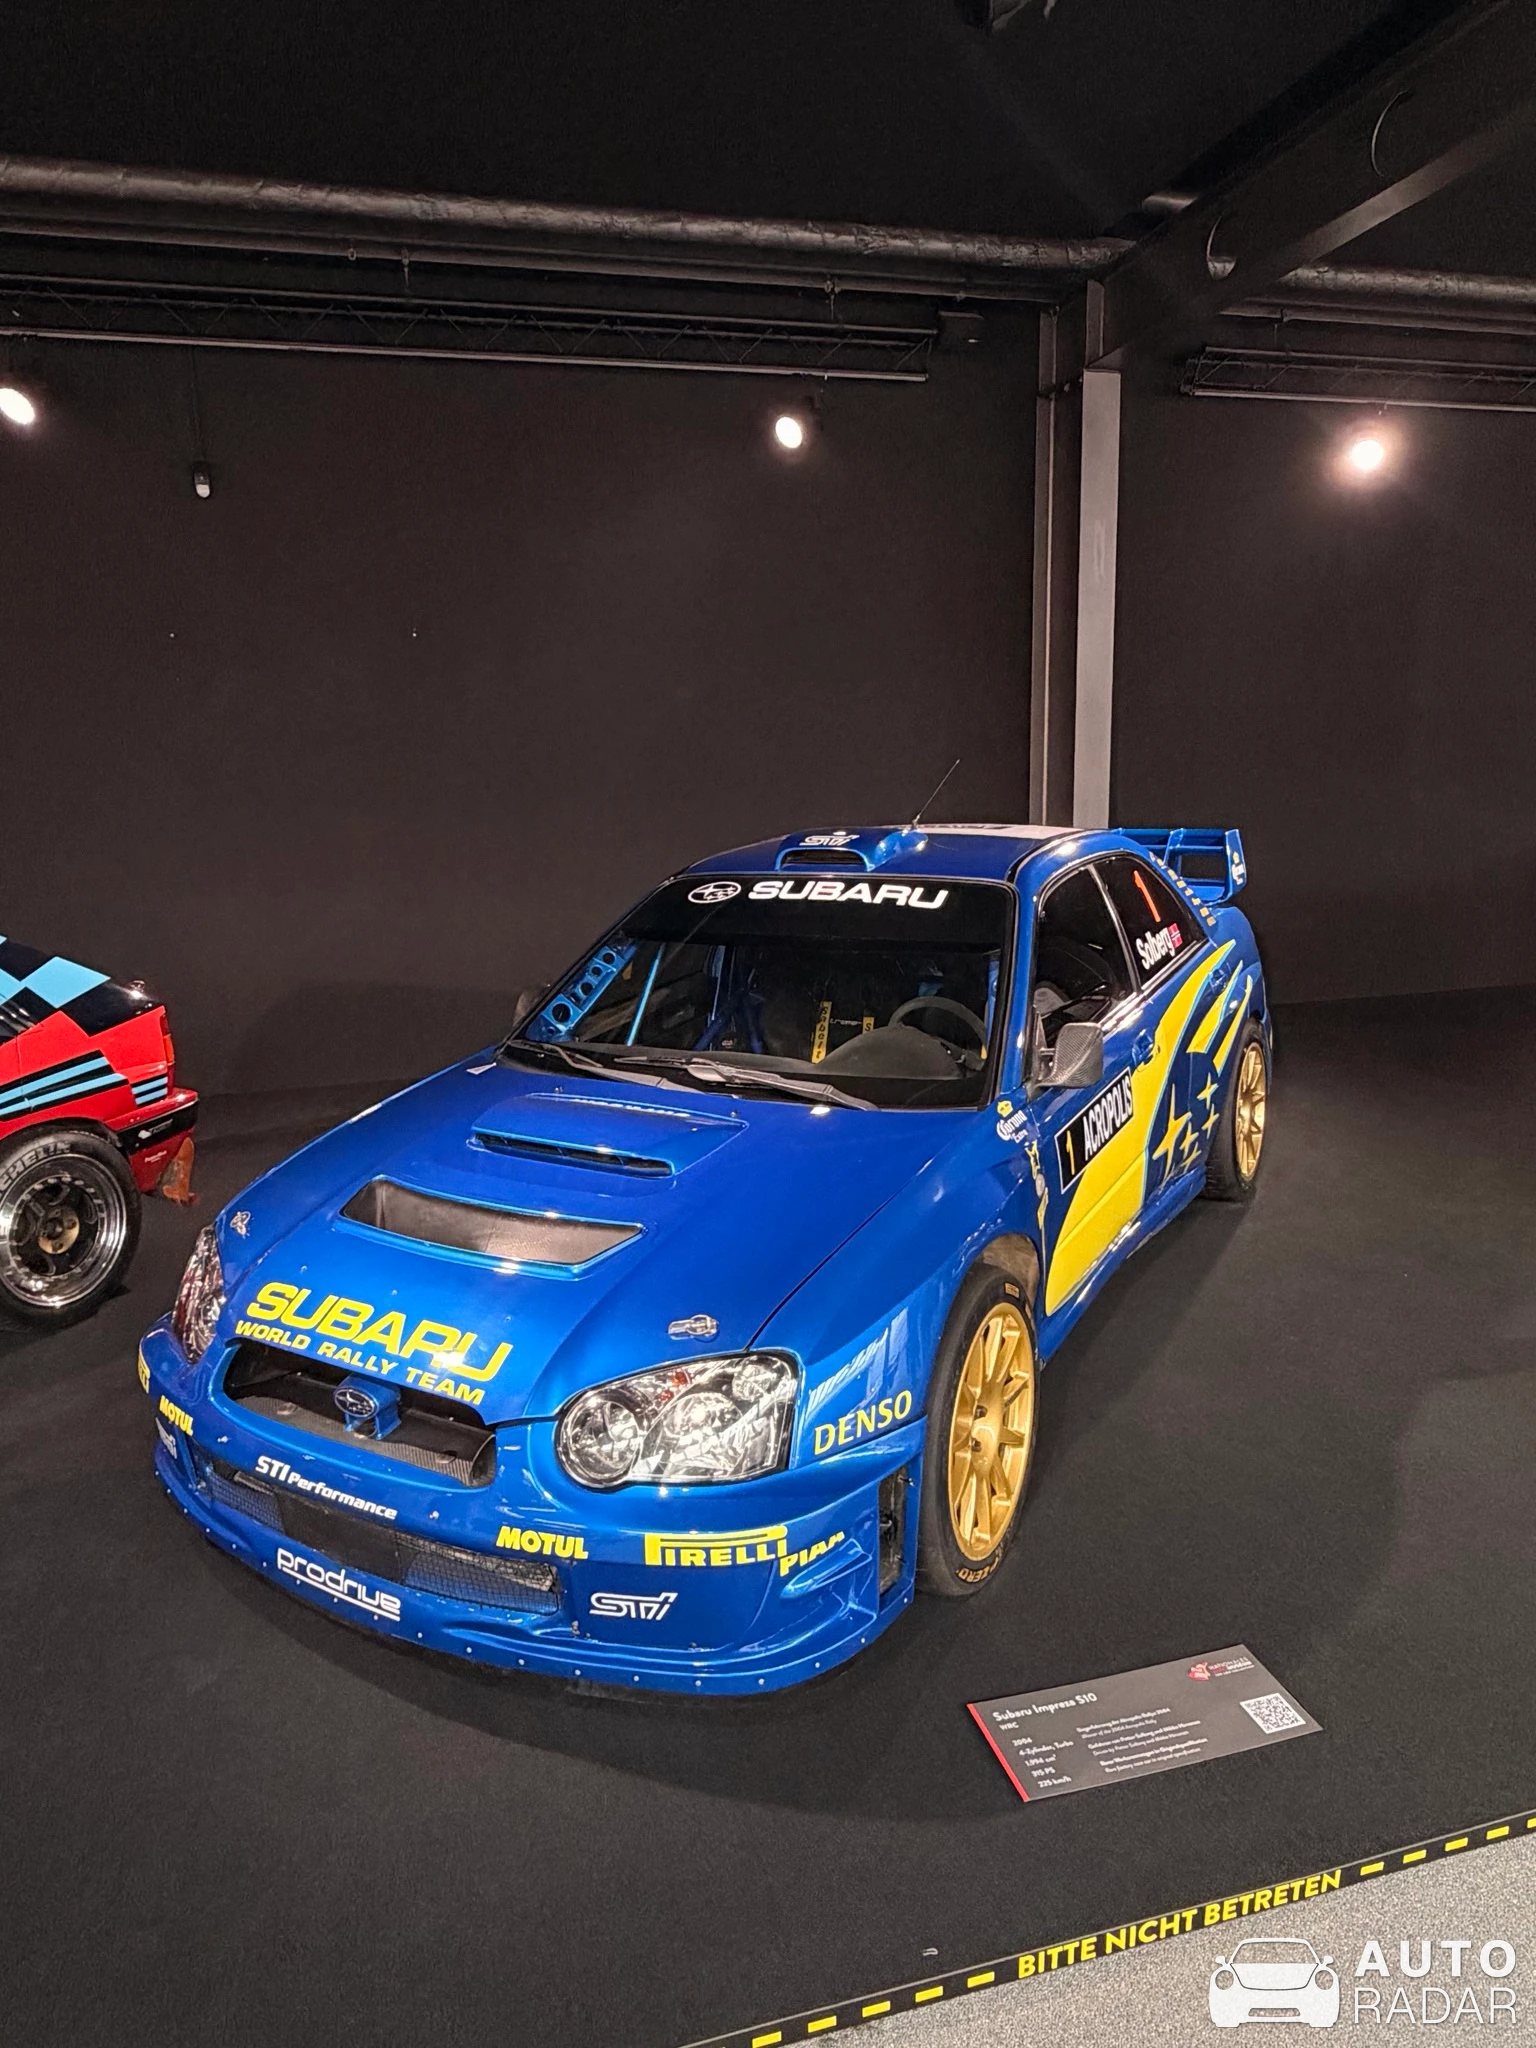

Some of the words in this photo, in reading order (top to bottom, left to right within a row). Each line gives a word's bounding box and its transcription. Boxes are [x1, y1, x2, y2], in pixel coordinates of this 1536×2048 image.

[748, 881, 949, 910] SUBARU
[1134, 870, 1161, 923] 1
[1135, 927, 1176, 971] Solberg
[1065, 1130, 1075, 1175] 1
[1083, 1075, 1133, 1161] ACROPOLIS
[246, 1282, 514, 1382] SUBARU
[235, 1320, 311, 1350] WORLD
[316, 1341, 399, 1375] RALLY
[405, 1366, 486, 1405] TEAM
[159, 1395, 194, 1436] MOTUL
[814, 1390, 912, 1455] DENSO
[255, 1455, 291, 1481] STI
[287, 1471, 398, 1520] Performance
[496, 1525, 589, 1560] MOTUL
[644, 1525, 788, 1566] PIRELLI
[277, 1547, 401, 1616] prodrive
[992, 1708, 1033, 1722] Subaru
[1032, 1699, 1076, 1714] Impreza
[1075, 1693, 1098, 1705] S10
[999, 1721, 1020, 1731] WRC
[1012, 1737, 1033, 1747] 2004
[1044, 1766, 1056, 1775] PS
[1017, 1937, 1097, 1979] BITTE
[1104, 1908, 1198, 1955] NICHT
[1203, 1869, 1342, 1926] BETRETEN
